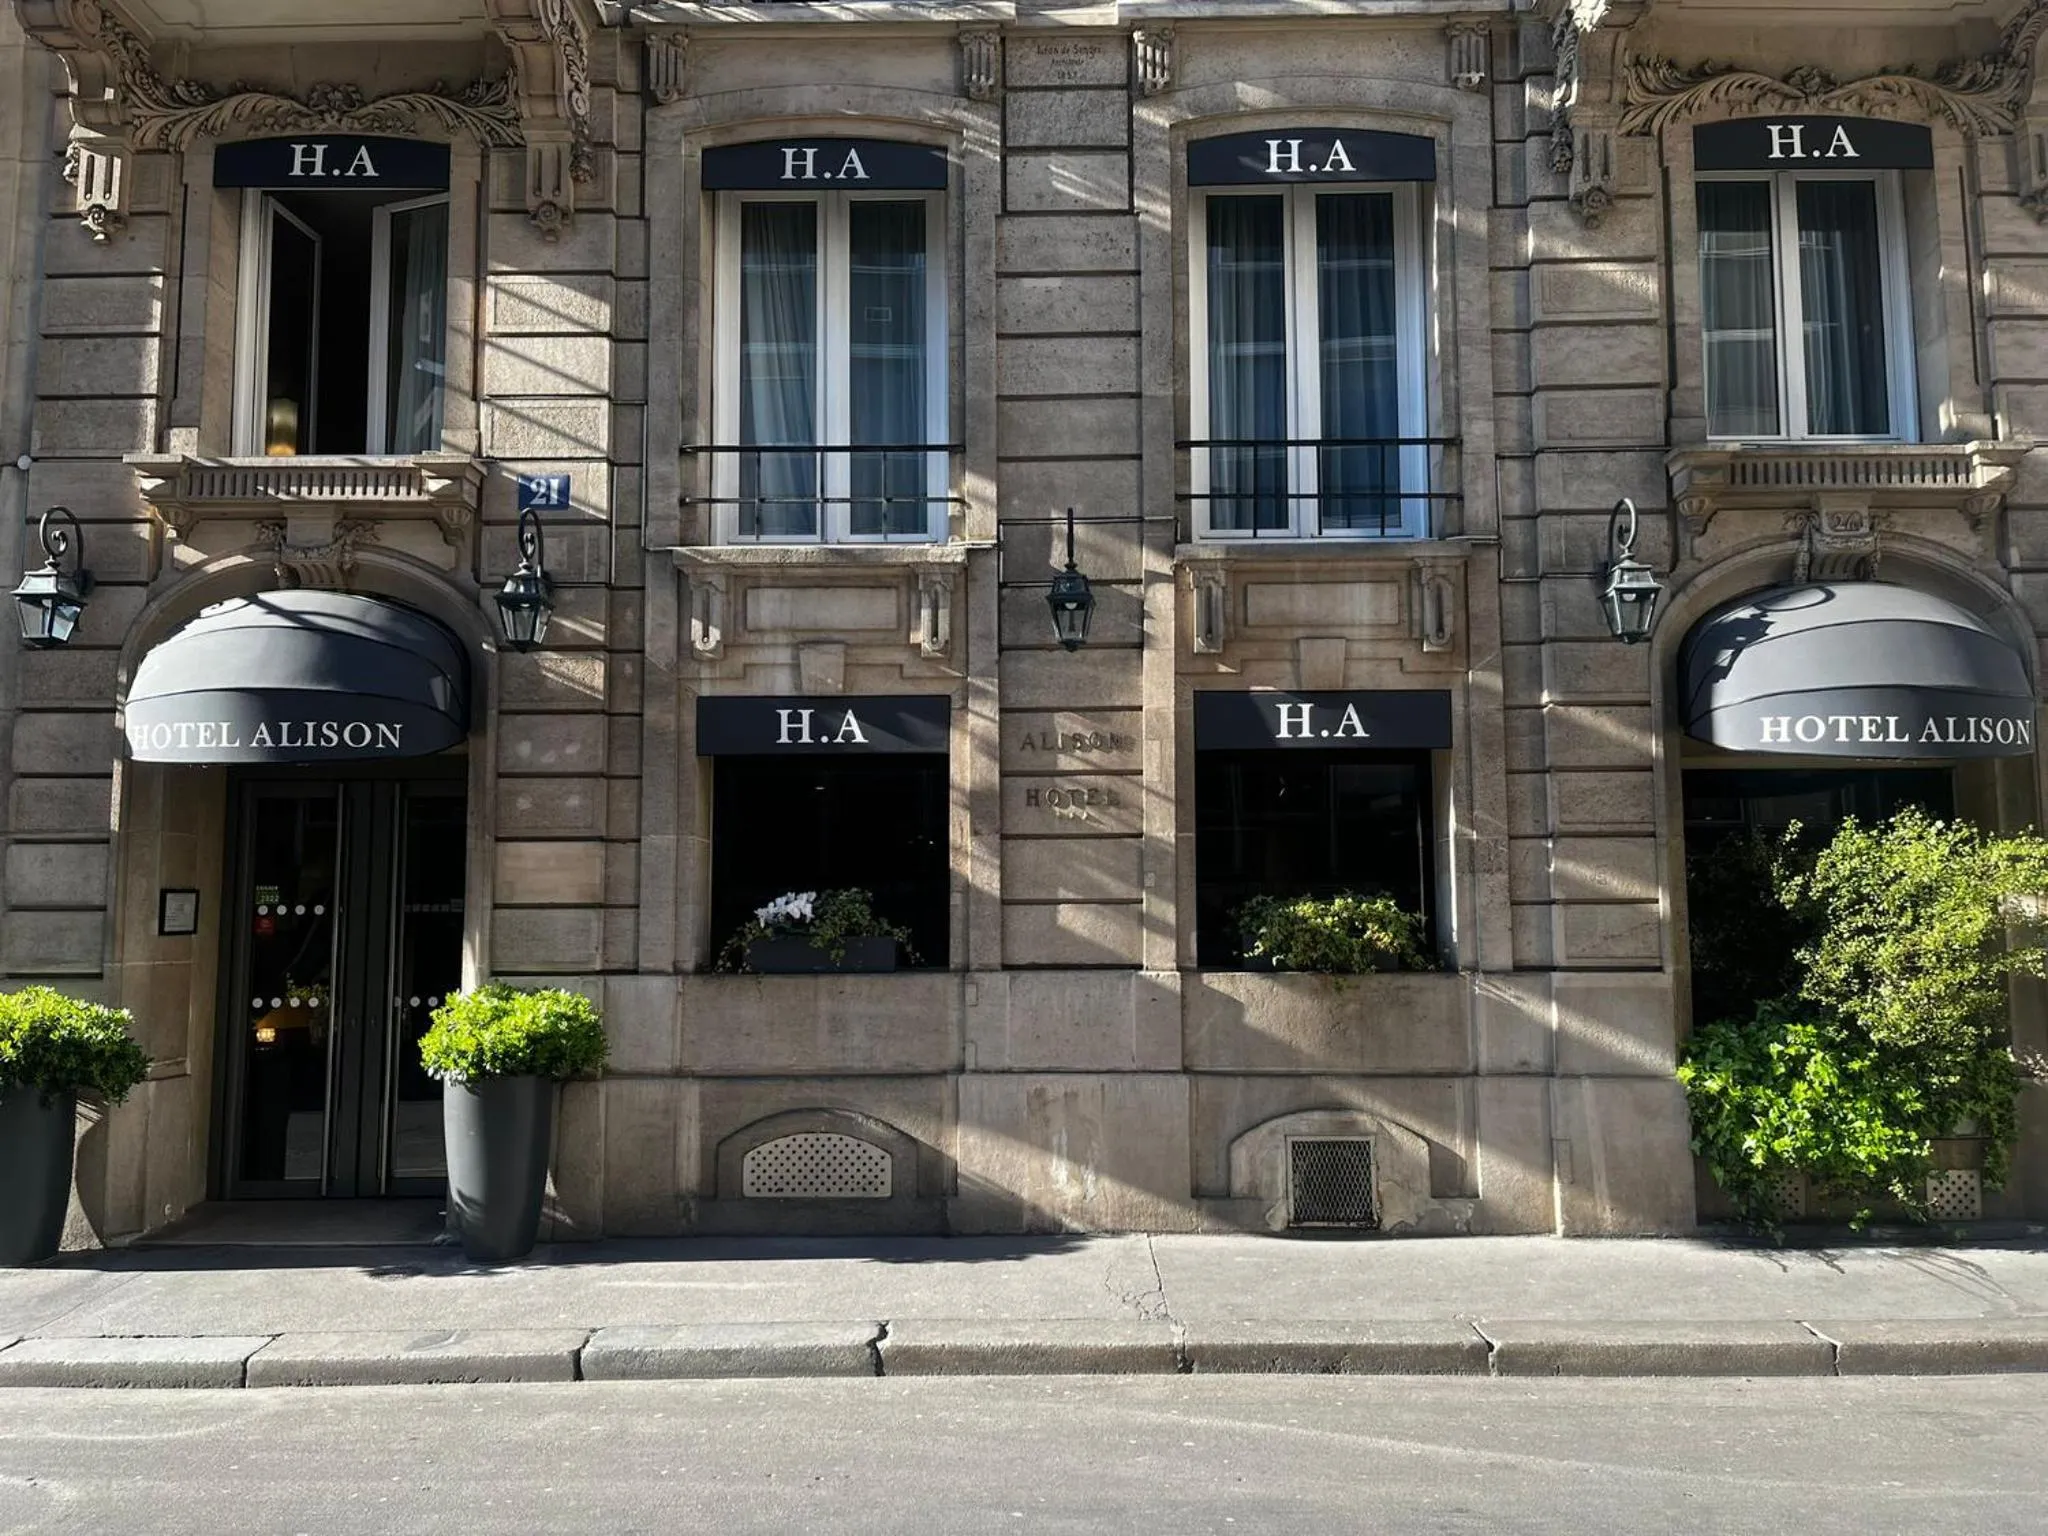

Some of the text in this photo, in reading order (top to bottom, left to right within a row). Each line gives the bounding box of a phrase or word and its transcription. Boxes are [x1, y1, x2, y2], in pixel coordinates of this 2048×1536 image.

[1265, 139, 1357, 173] H.A
[1767, 124, 1860, 158] H.A
[289, 144, 379, 176] H.A
[781, 148, 869, 179] H.A
[529, 478, 560, 505] 21
[132, 721, 403, 751] HOTEL ALISON
[776, 709, 869, 743] H.A
[1275, 703, 1370, 739] H.A
[1759, 715, 2031, 745] HOTEL ALISON
[1019, 731, 1121, 752] ALISON
[1025, 788, 1121, 808] HOTEL
